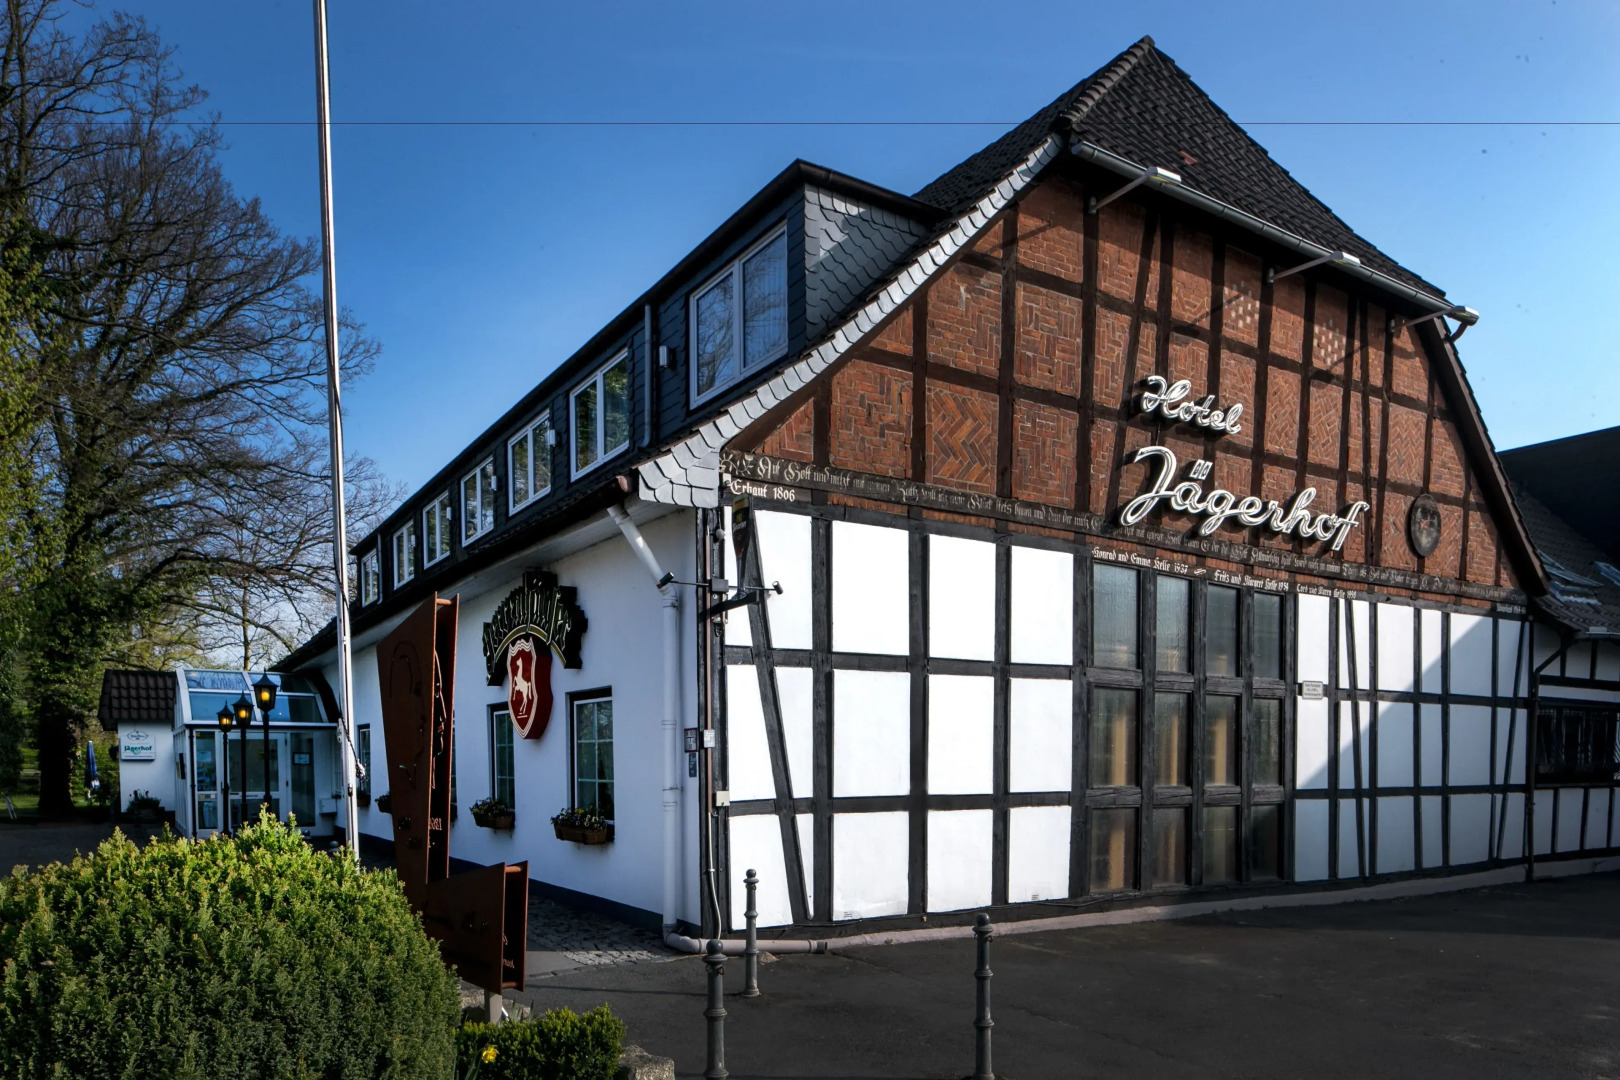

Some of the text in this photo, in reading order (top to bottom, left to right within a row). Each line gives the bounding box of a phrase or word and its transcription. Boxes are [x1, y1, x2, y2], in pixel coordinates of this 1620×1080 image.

[1140, 375, 1243, 435] Hotel
[730, 479, 795, 502] Erbaut 1806
[1120, 445, 1370, 551] Jägerhof
